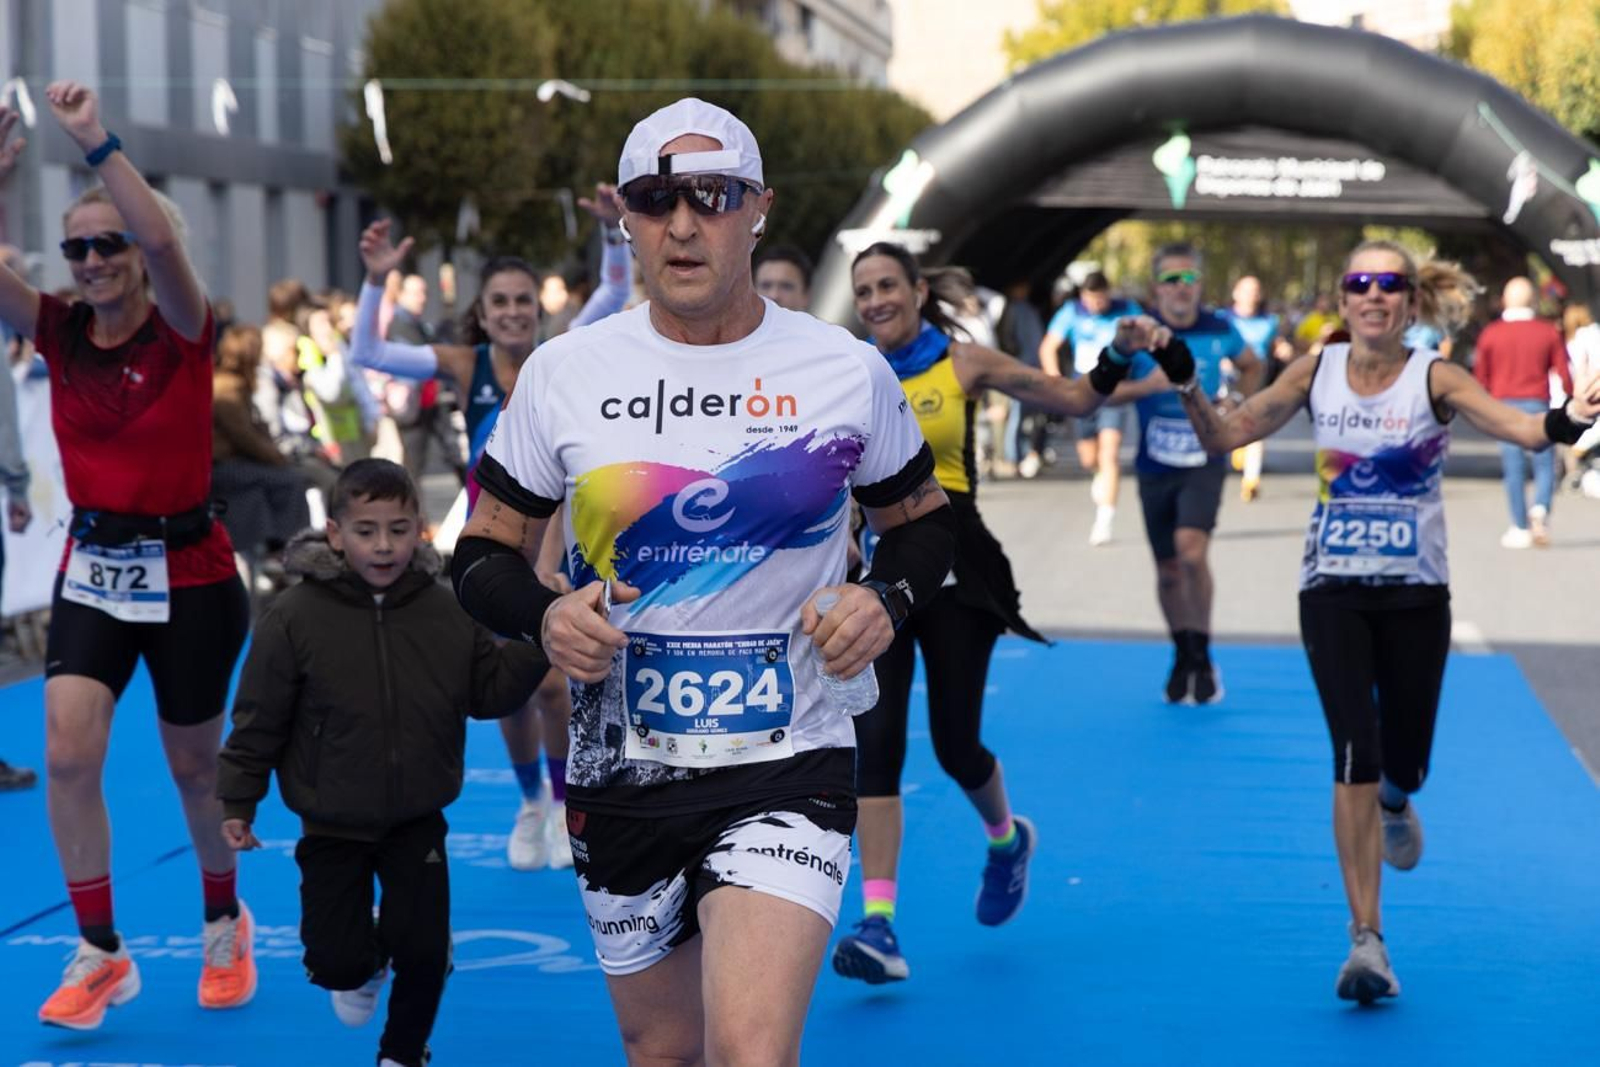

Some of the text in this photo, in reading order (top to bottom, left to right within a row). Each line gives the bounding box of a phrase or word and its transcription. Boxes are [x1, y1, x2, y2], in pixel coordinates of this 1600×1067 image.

[600, 377, 797, 435] calderón
[745, 425, 799, 434] desde 1949
[1318, 406, 1410, 436] calderón
[1326, 520, 1412, 549] 2250
[637, 539, 766, 563] entrénate
[90, 562, 149, 590] 872
[635, 667, 784, 717] 2624
[694, 718, 719, 728] LUIS
[596, 914, 660, 935] running
